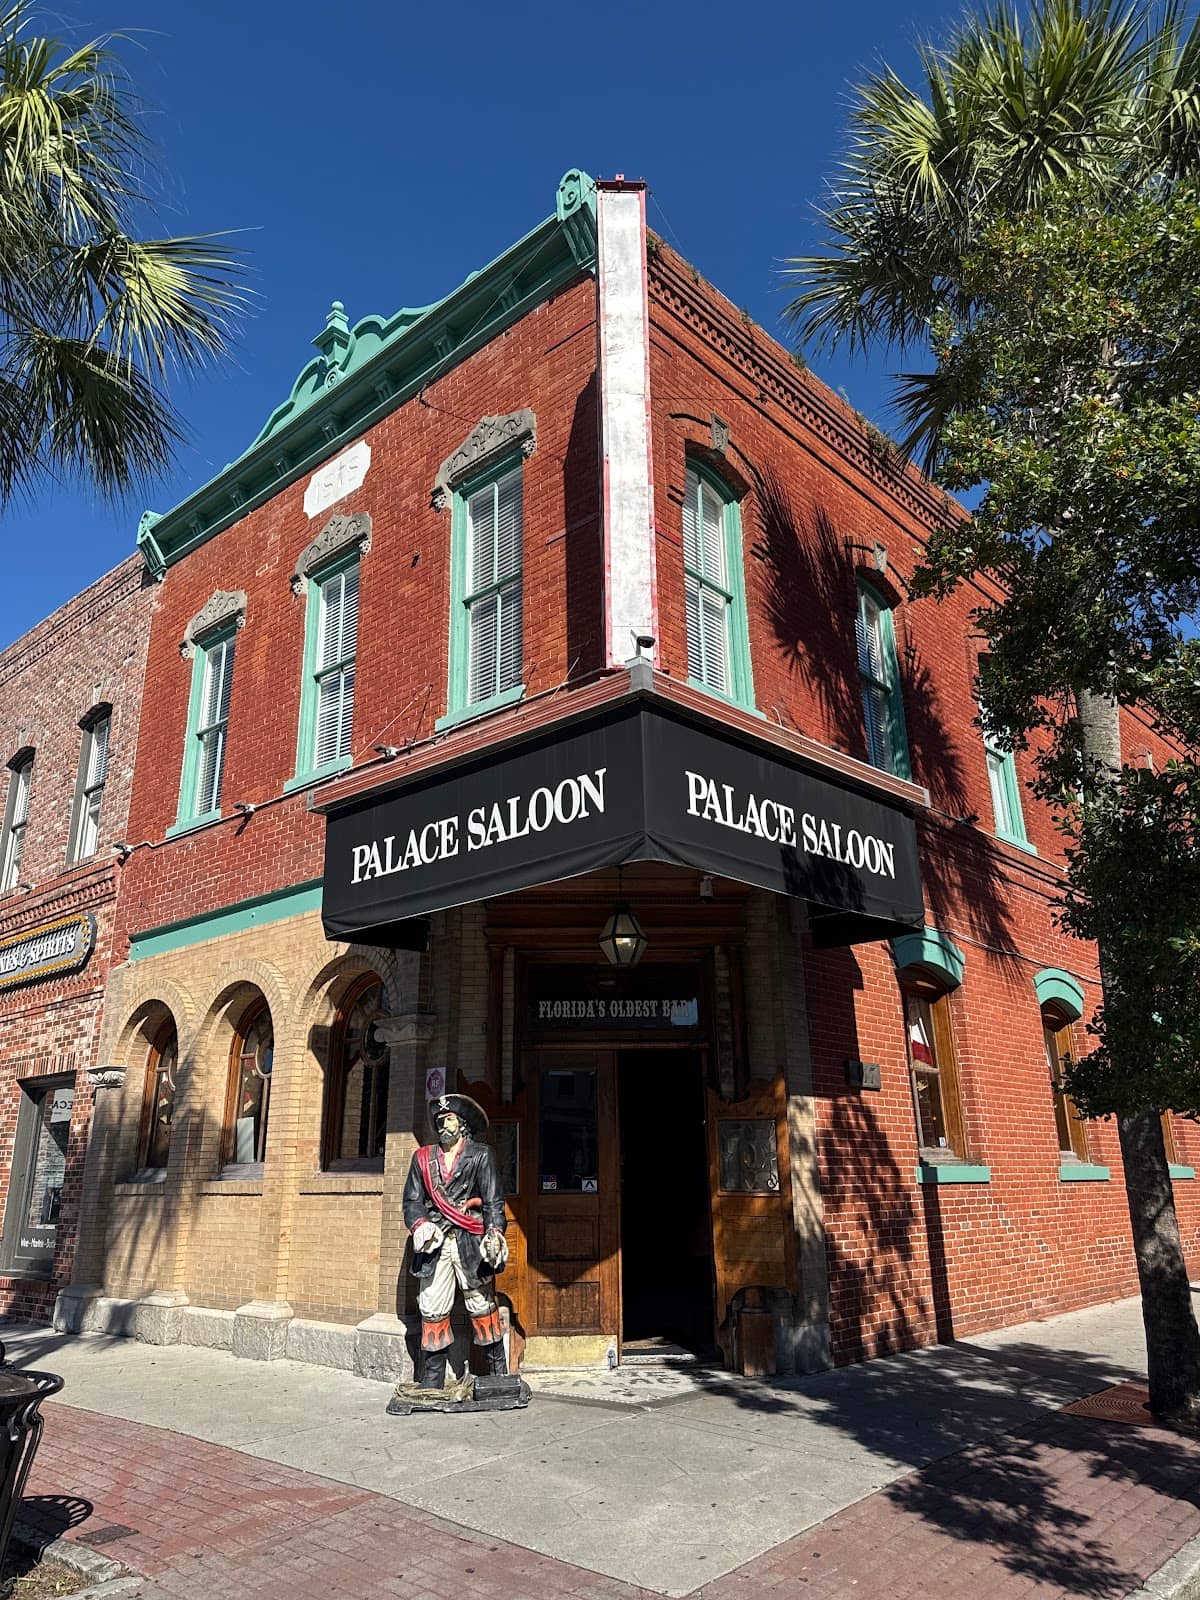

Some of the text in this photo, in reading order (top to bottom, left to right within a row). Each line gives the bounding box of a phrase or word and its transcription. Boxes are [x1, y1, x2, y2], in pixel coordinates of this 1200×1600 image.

[351, 768, 607, 885] PALACE SALOON
[685, 771, 895, 879] PALACE SALOON
[30, 933, 75, 963] SPIRITS
[538, 1000, 689, 1018] FLORIDA'S OLDEST BAR
